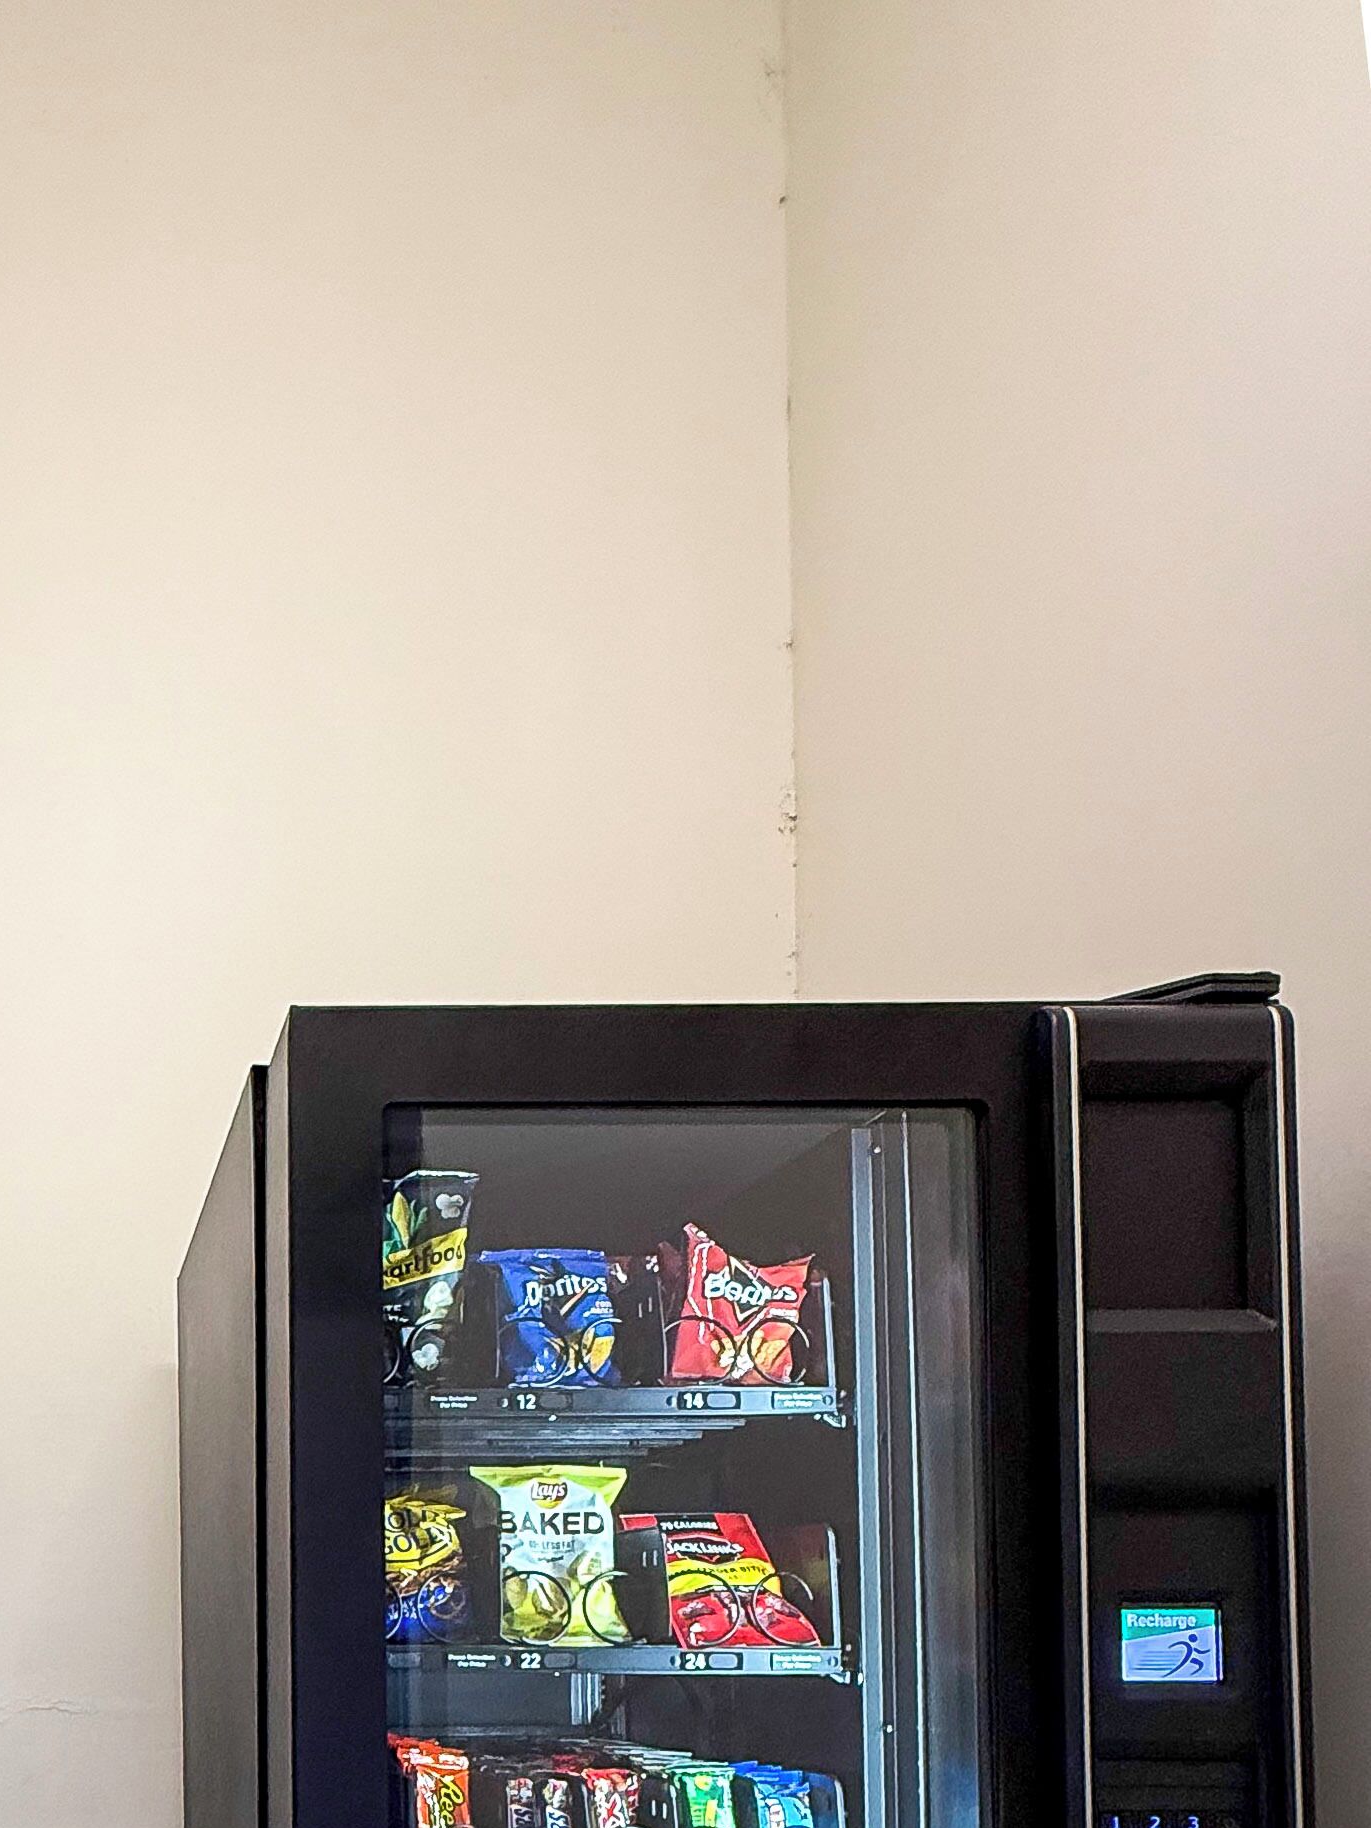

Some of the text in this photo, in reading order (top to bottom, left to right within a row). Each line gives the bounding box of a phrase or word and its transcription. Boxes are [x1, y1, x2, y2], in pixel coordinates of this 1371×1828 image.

[384, 1242, 464, 1278] artfood
[526, 1274, 608, 1307] Doritos
[517, 1394, 537, 1410] 12
[683, 1393, 705, 1409] 14
[388, 1509, 440, 1533] OLD
[500, 1511, 605, 1536] BAKED
[1127, 1613, 1197, 1631] Recharge
[520, 1653, 541, 1669] 22
[684, 1653, 706, 1670] 24
